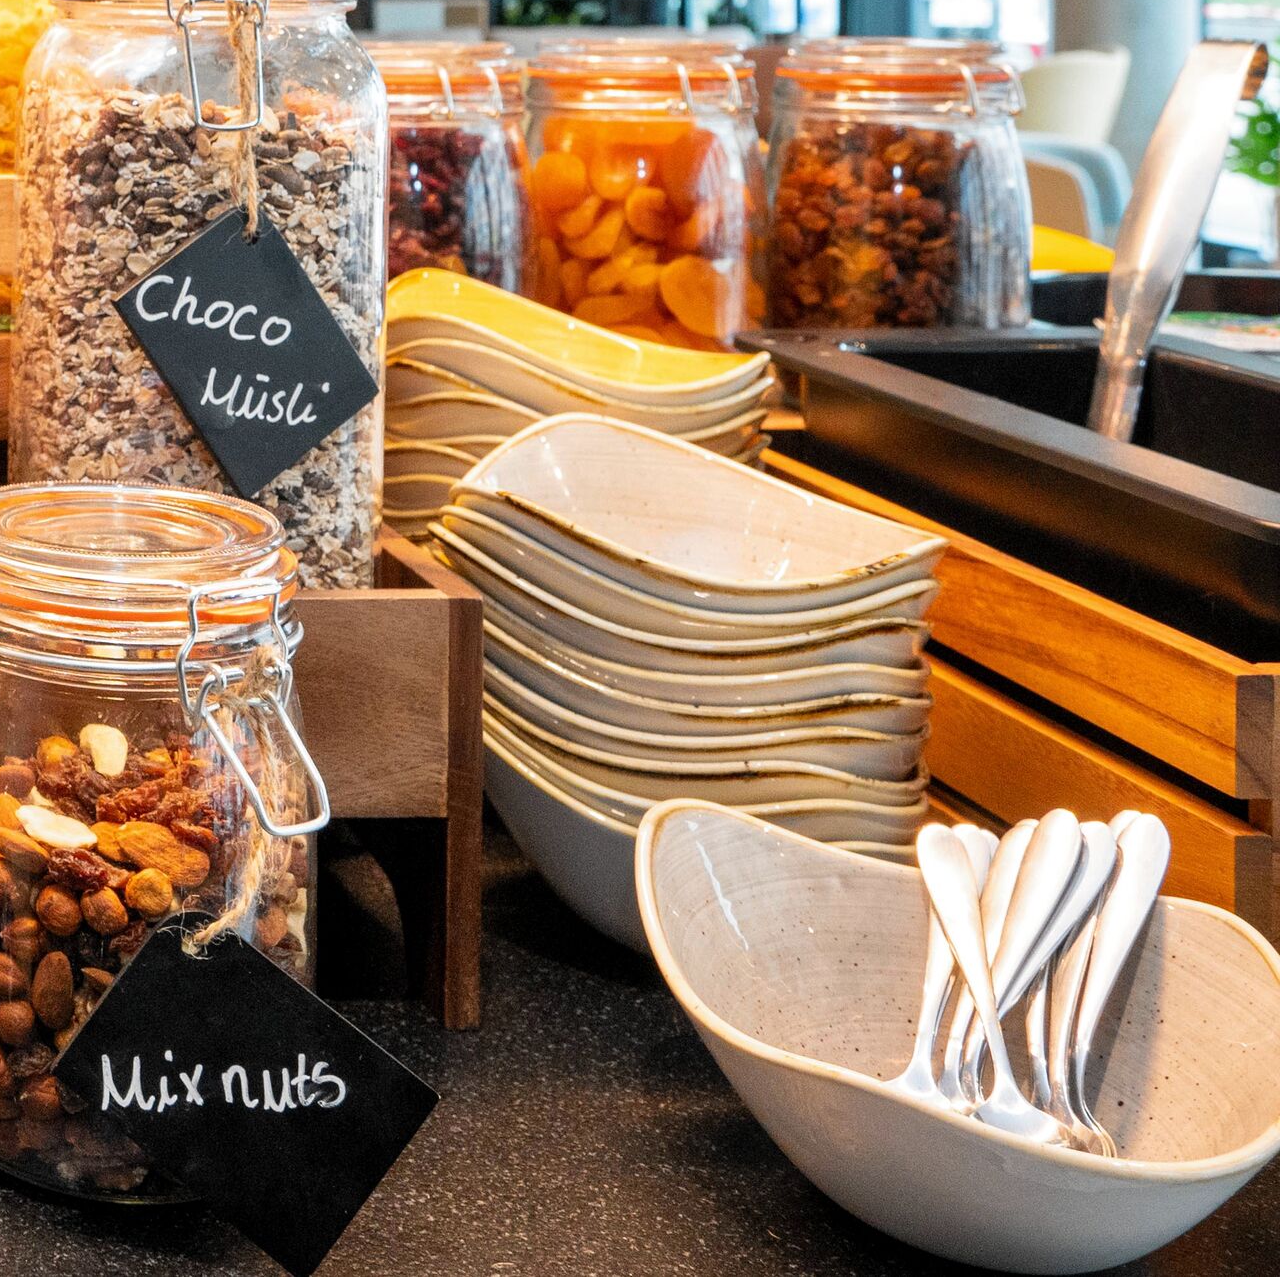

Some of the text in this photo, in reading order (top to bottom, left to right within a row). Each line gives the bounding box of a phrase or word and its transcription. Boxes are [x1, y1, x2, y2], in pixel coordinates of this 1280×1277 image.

[135, 274, 292, 346] Choco
[101, 1049, 346, 1112] Mix nuts
